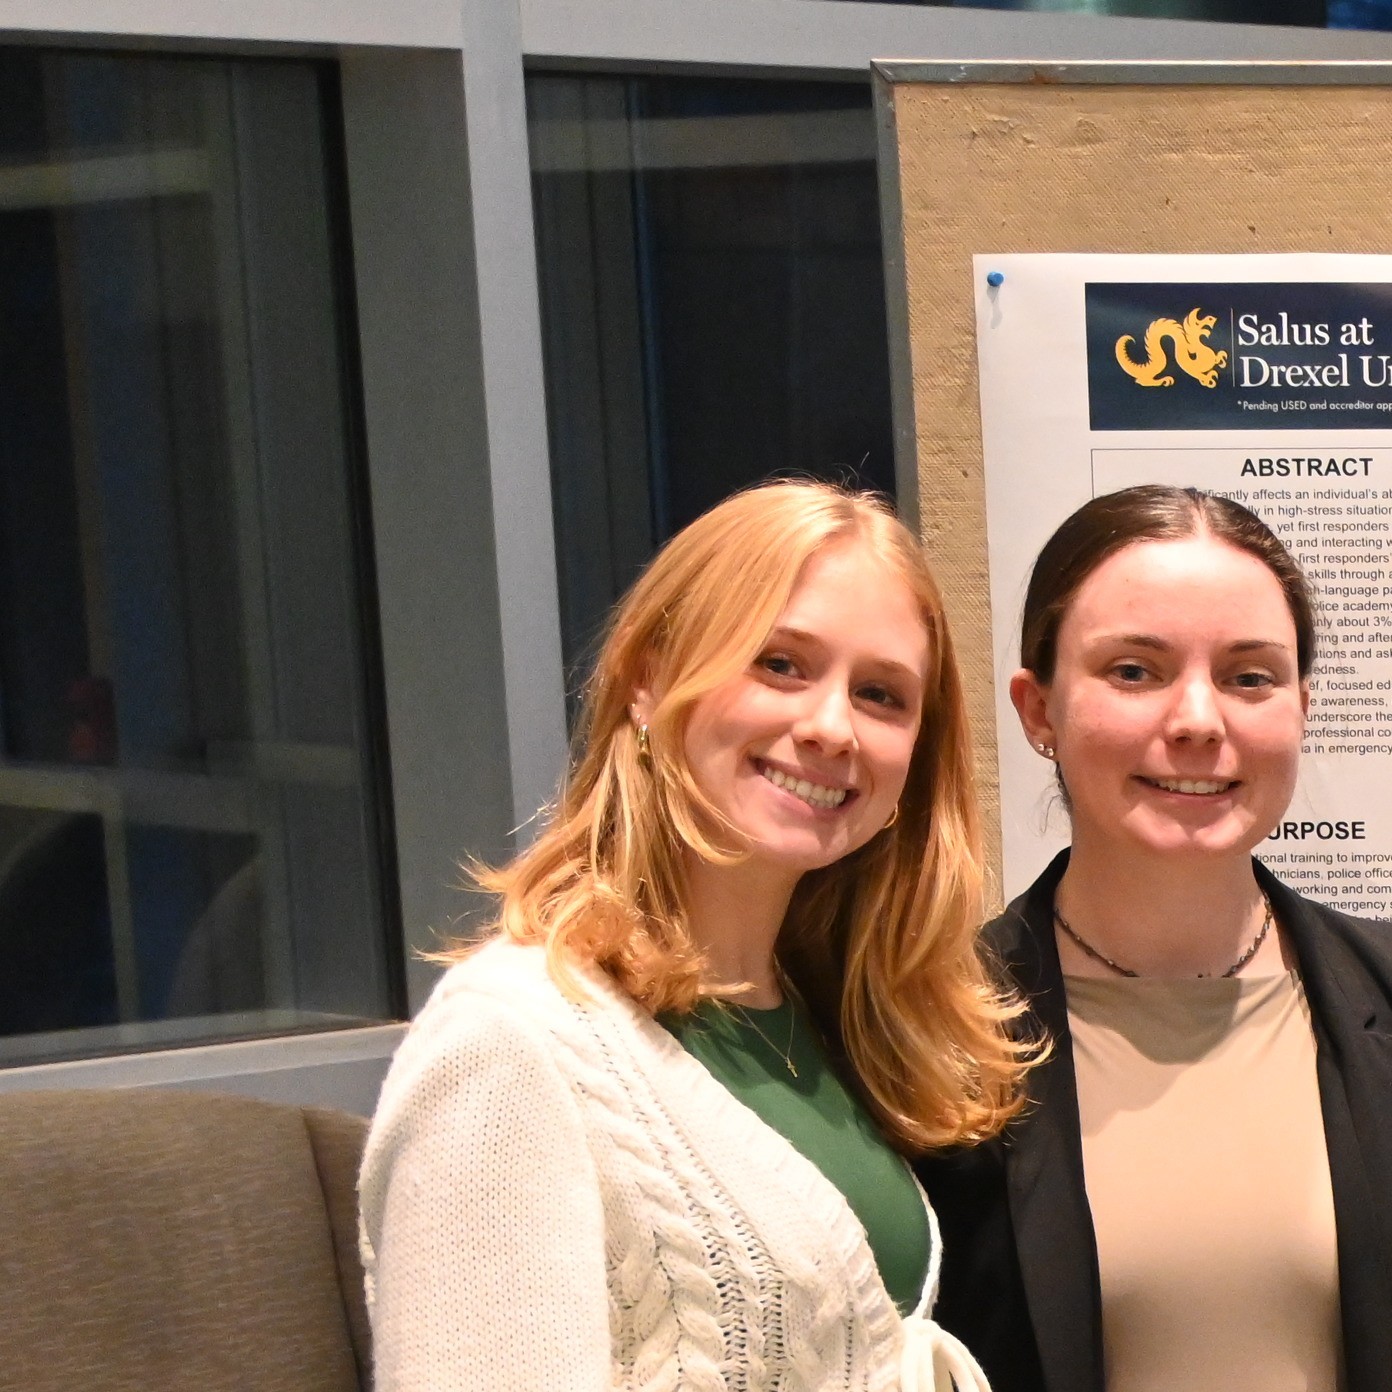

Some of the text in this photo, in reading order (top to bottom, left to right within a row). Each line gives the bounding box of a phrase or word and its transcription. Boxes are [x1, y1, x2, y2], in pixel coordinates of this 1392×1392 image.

[1239, 312, 1374, 345] Salus at
[1240, 354, 1350, 387] Drexel
[1281, 400, 1307, 410] USED
[1309, 400, 1327, 410] and
[1329, 400, 1374, 410] accreditor
[1241, 457, 1373, 477] ABSTRACT
[1252, 489, 1292, 500] affects
[1295, 491, 1309, 500] an
[1313, 488, 1378, 500] individual's
[1267, 821, 1366, 841] URPOSE
